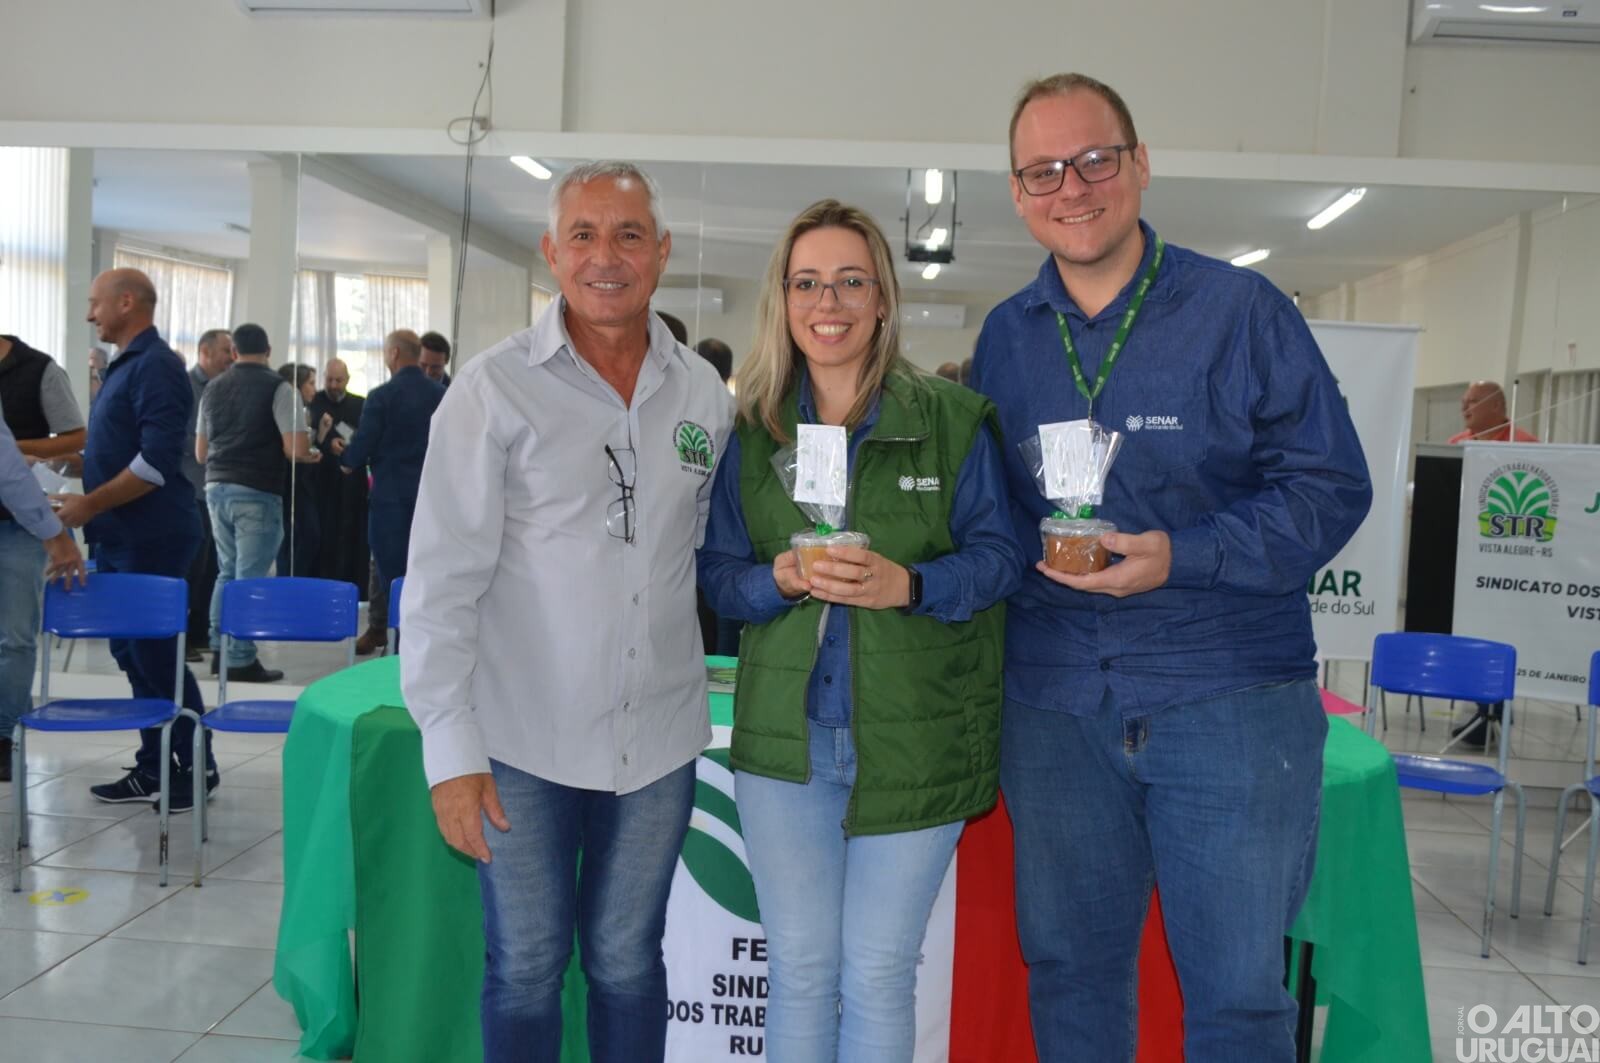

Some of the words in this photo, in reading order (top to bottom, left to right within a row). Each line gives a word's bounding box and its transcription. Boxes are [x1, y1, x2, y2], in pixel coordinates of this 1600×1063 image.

[1145, 415, 1178, 425] SENAR
[1490, 514, 1545, 538] STR
[1479, 543, 1502, 553] VISTA
[1503, 545, 1535, 556] ALEGRE
[1476, 576, 1562, 595] SINDICATO
[1566, 583, 1600, 598] DOS
[1331, 599, 1350, 614] do
[1353, 600, 1375, 615] Sul
[1529, 670, 1541, 678] DE
[1544, 672, 1587, 684] JANEIRO
[732, 937, 768, 962] FE
[729, 1034, 764, 1056] RU
